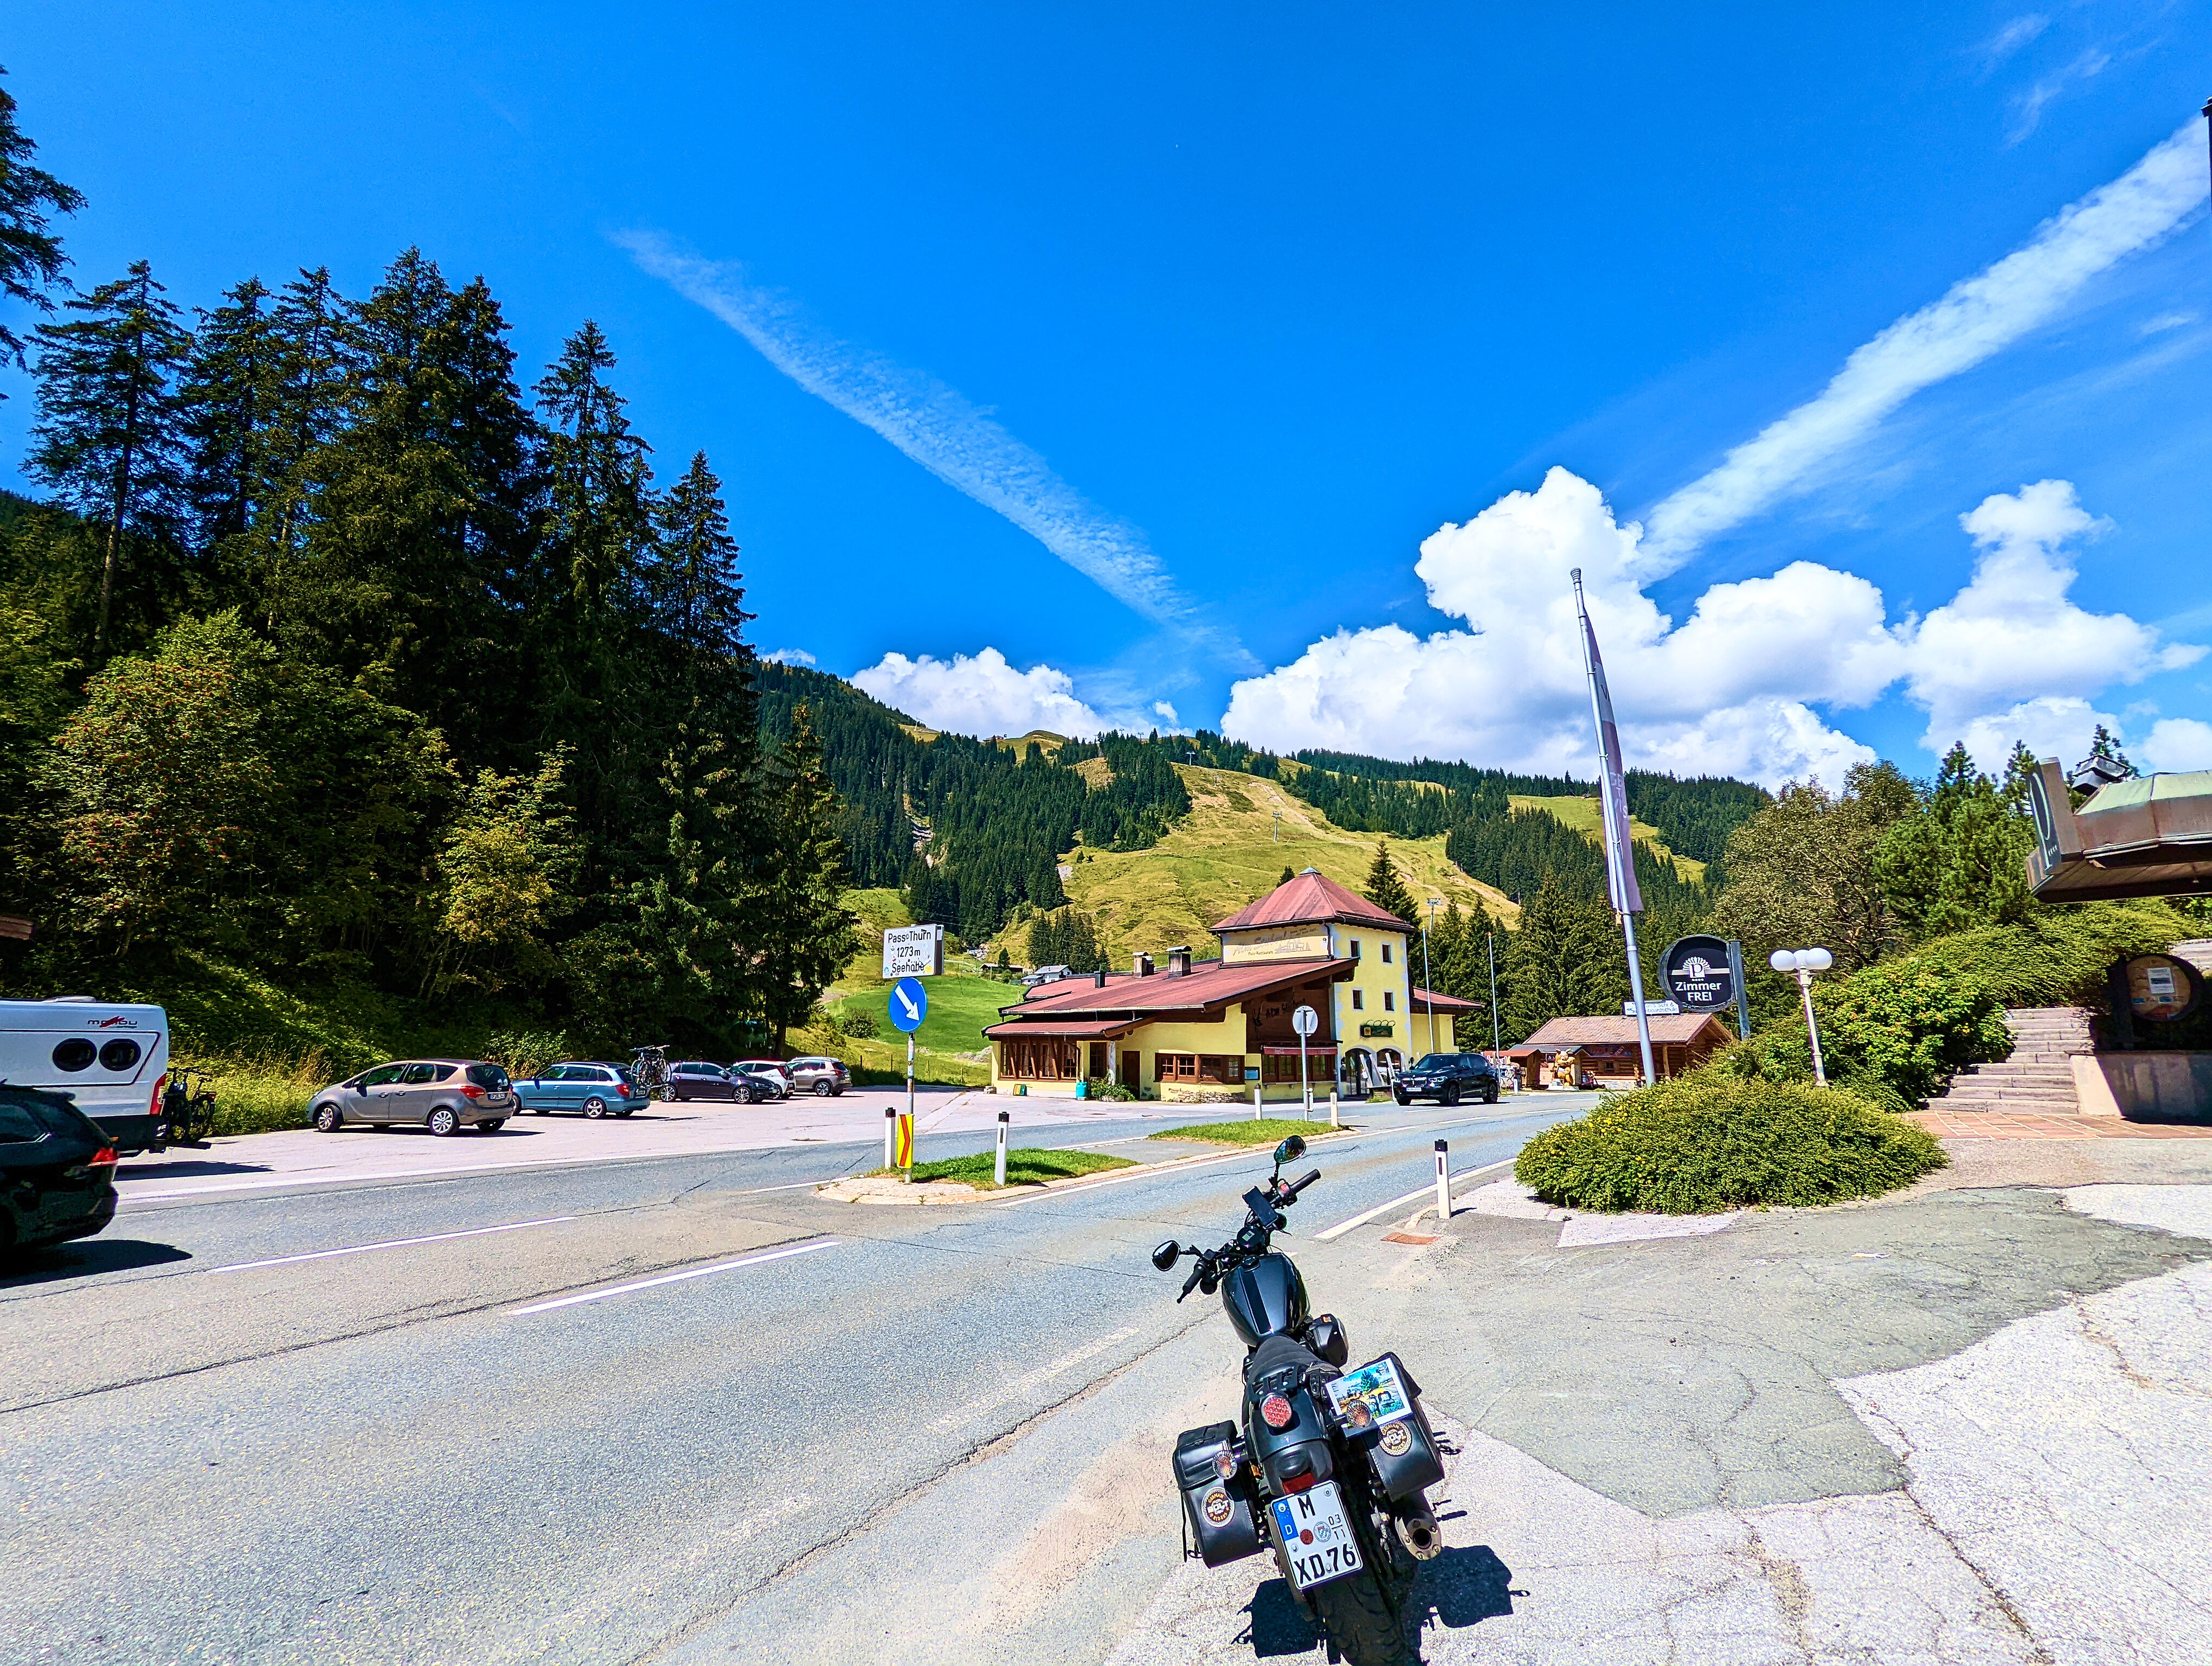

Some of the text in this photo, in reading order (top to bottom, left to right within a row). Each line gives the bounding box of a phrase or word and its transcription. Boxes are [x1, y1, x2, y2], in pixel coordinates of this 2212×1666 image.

[888, 931, 931, 944] Pass Thurn
[897, 946, 914, 958] 1273
[1675, 982, 1722, 991] Zimmer
[1687, 991, 1713, 1001] FREI
[1207, 1500, 1229, 1514] BOLT
[1297, 1494, 1316, 1519] M
[1328, 1514, 1341, 1525] 03
[1285, 1525, 1293, 1535] D
